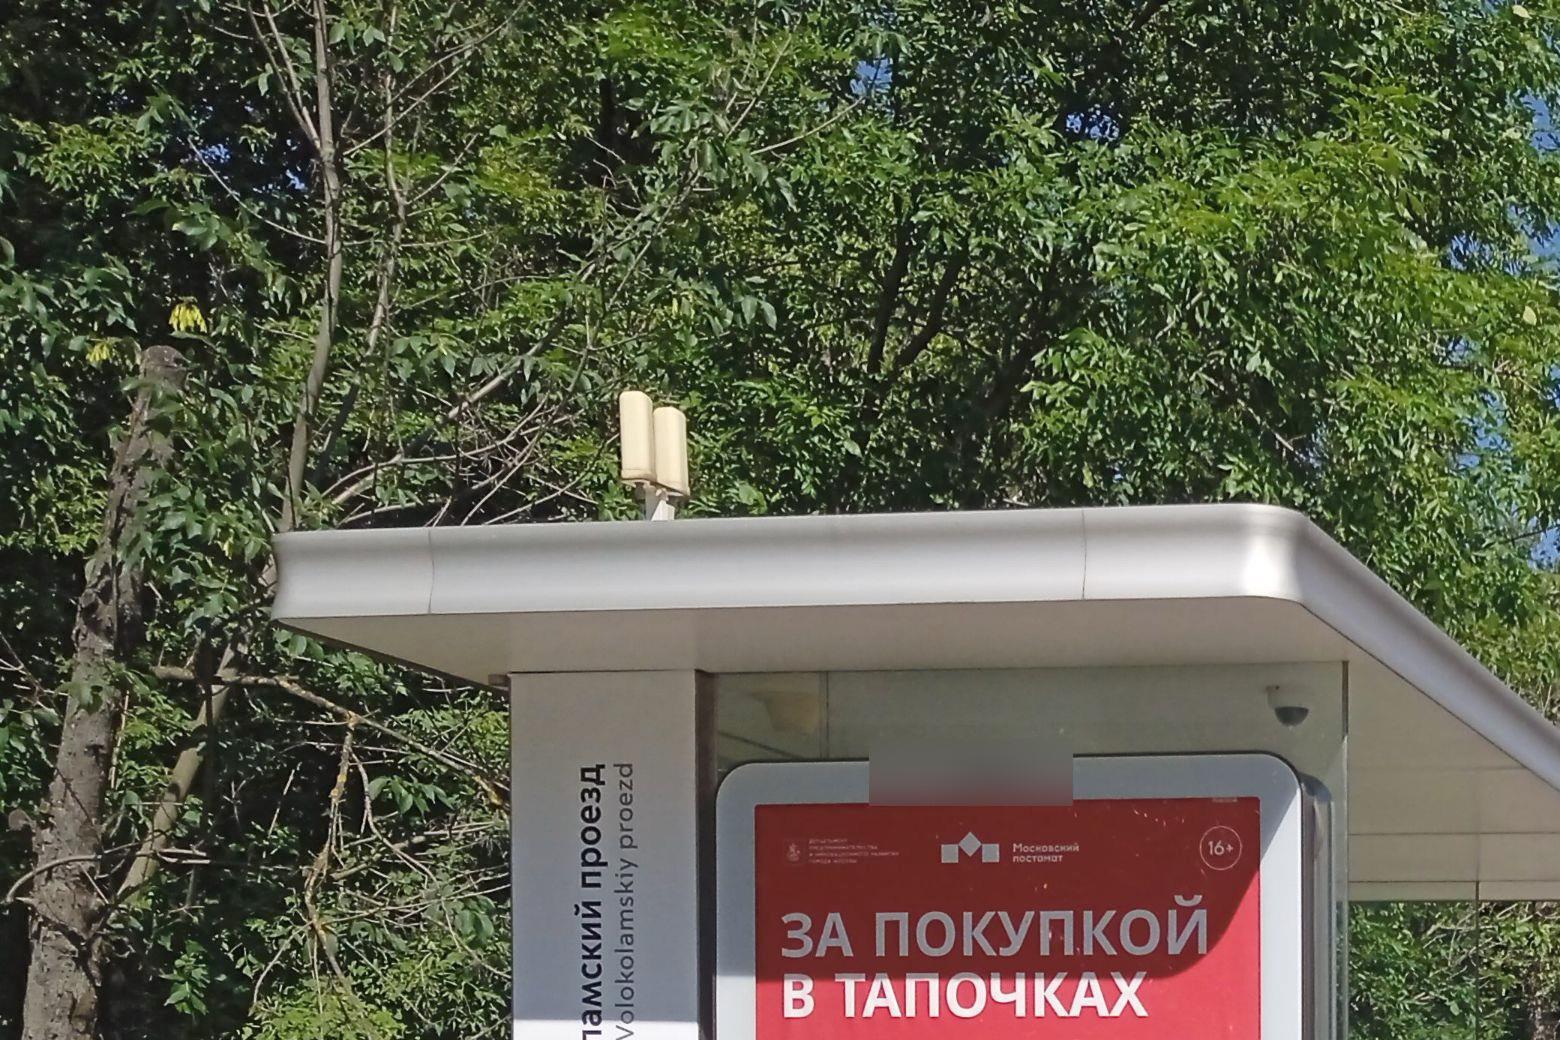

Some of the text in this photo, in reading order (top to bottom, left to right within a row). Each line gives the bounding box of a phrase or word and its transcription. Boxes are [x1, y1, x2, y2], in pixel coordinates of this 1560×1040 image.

[580, 764, 608, 889] проезд
[614, 763, 638, 849] proezd
[1012, 841, 1080, 853] Московский
[1012, 855, 1063, 863] постамат
[1207, 840, 1234, 856] 16+
[781, 894, 1208, 958] ЗА ПОКУПКОЙ
[783, 971, 1148, 1019] В ТАПОЧКАХ
